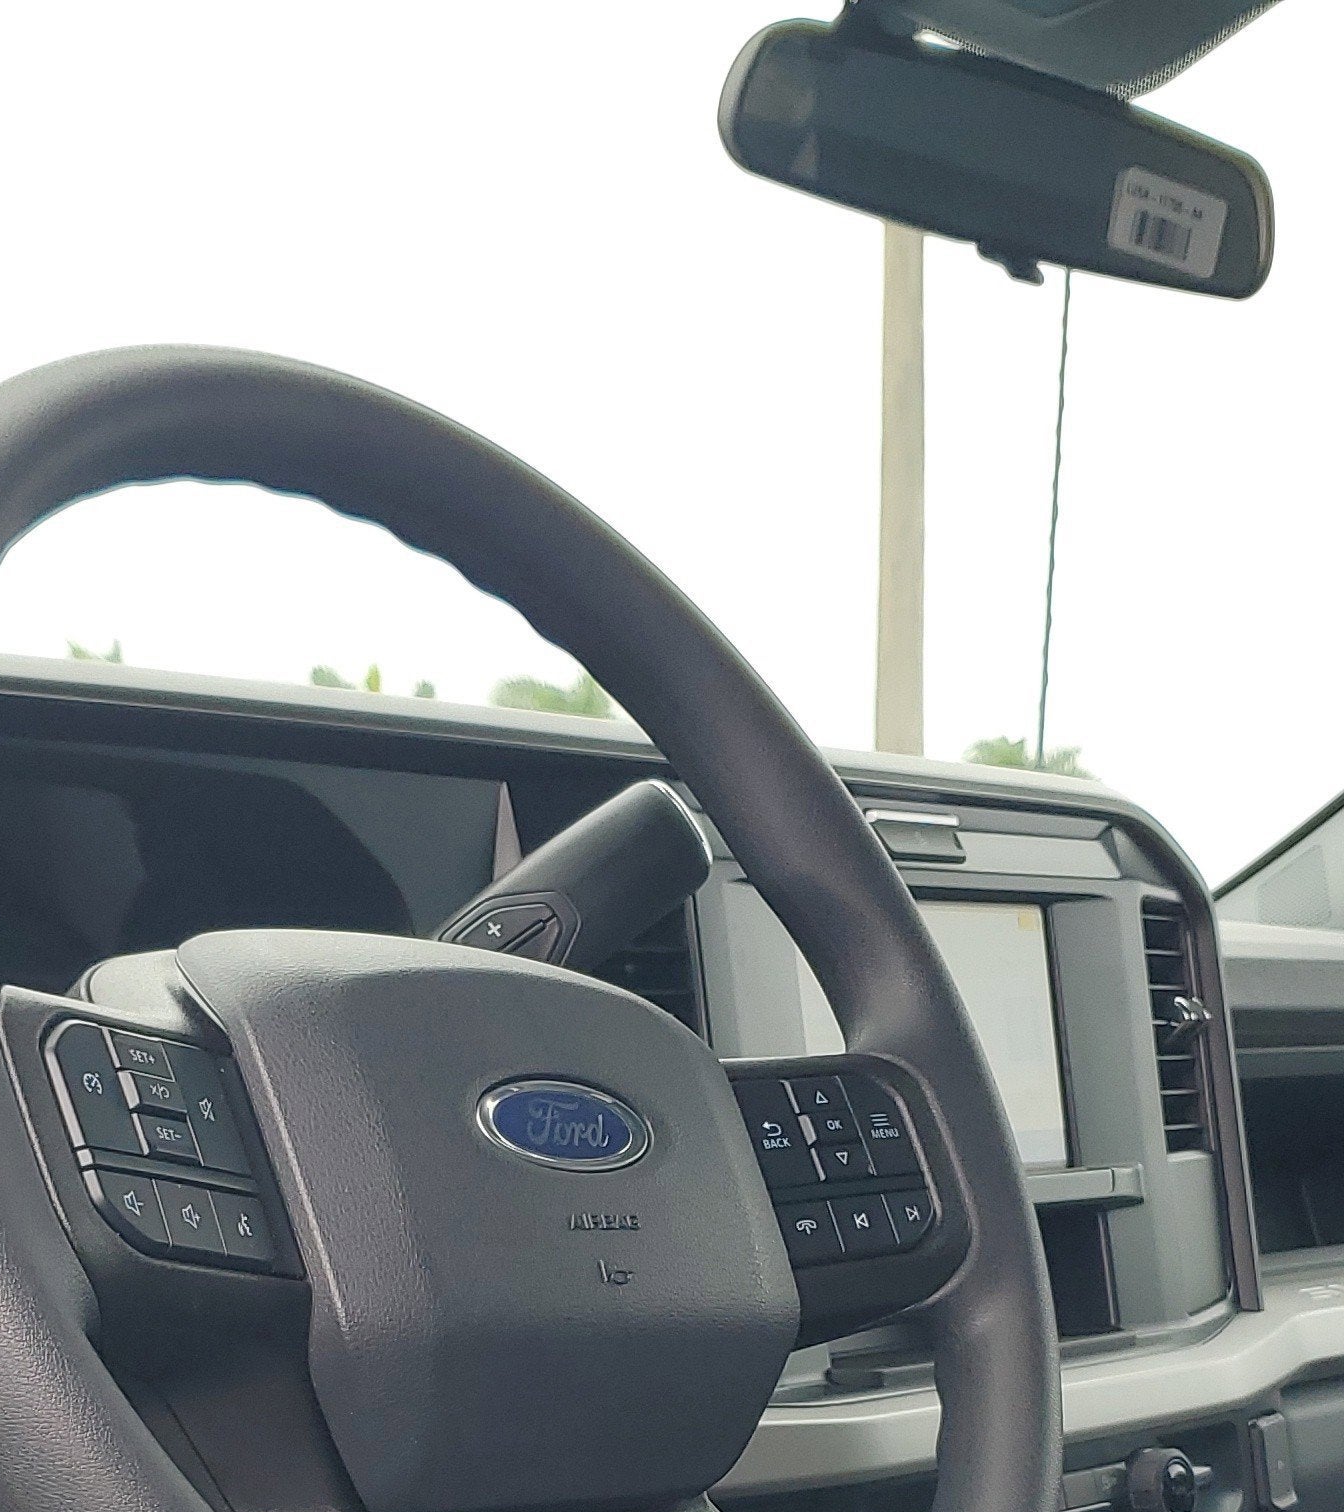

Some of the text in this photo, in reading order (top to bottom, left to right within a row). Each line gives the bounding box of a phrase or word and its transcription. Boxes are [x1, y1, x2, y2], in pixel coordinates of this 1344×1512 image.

[526, 1100, 610, 1148] Ford
[826, 1119, 844, 1131] OK
[870, 1127, 900, 1140] MENU
[762, 1136, 792, 1150] BACK
